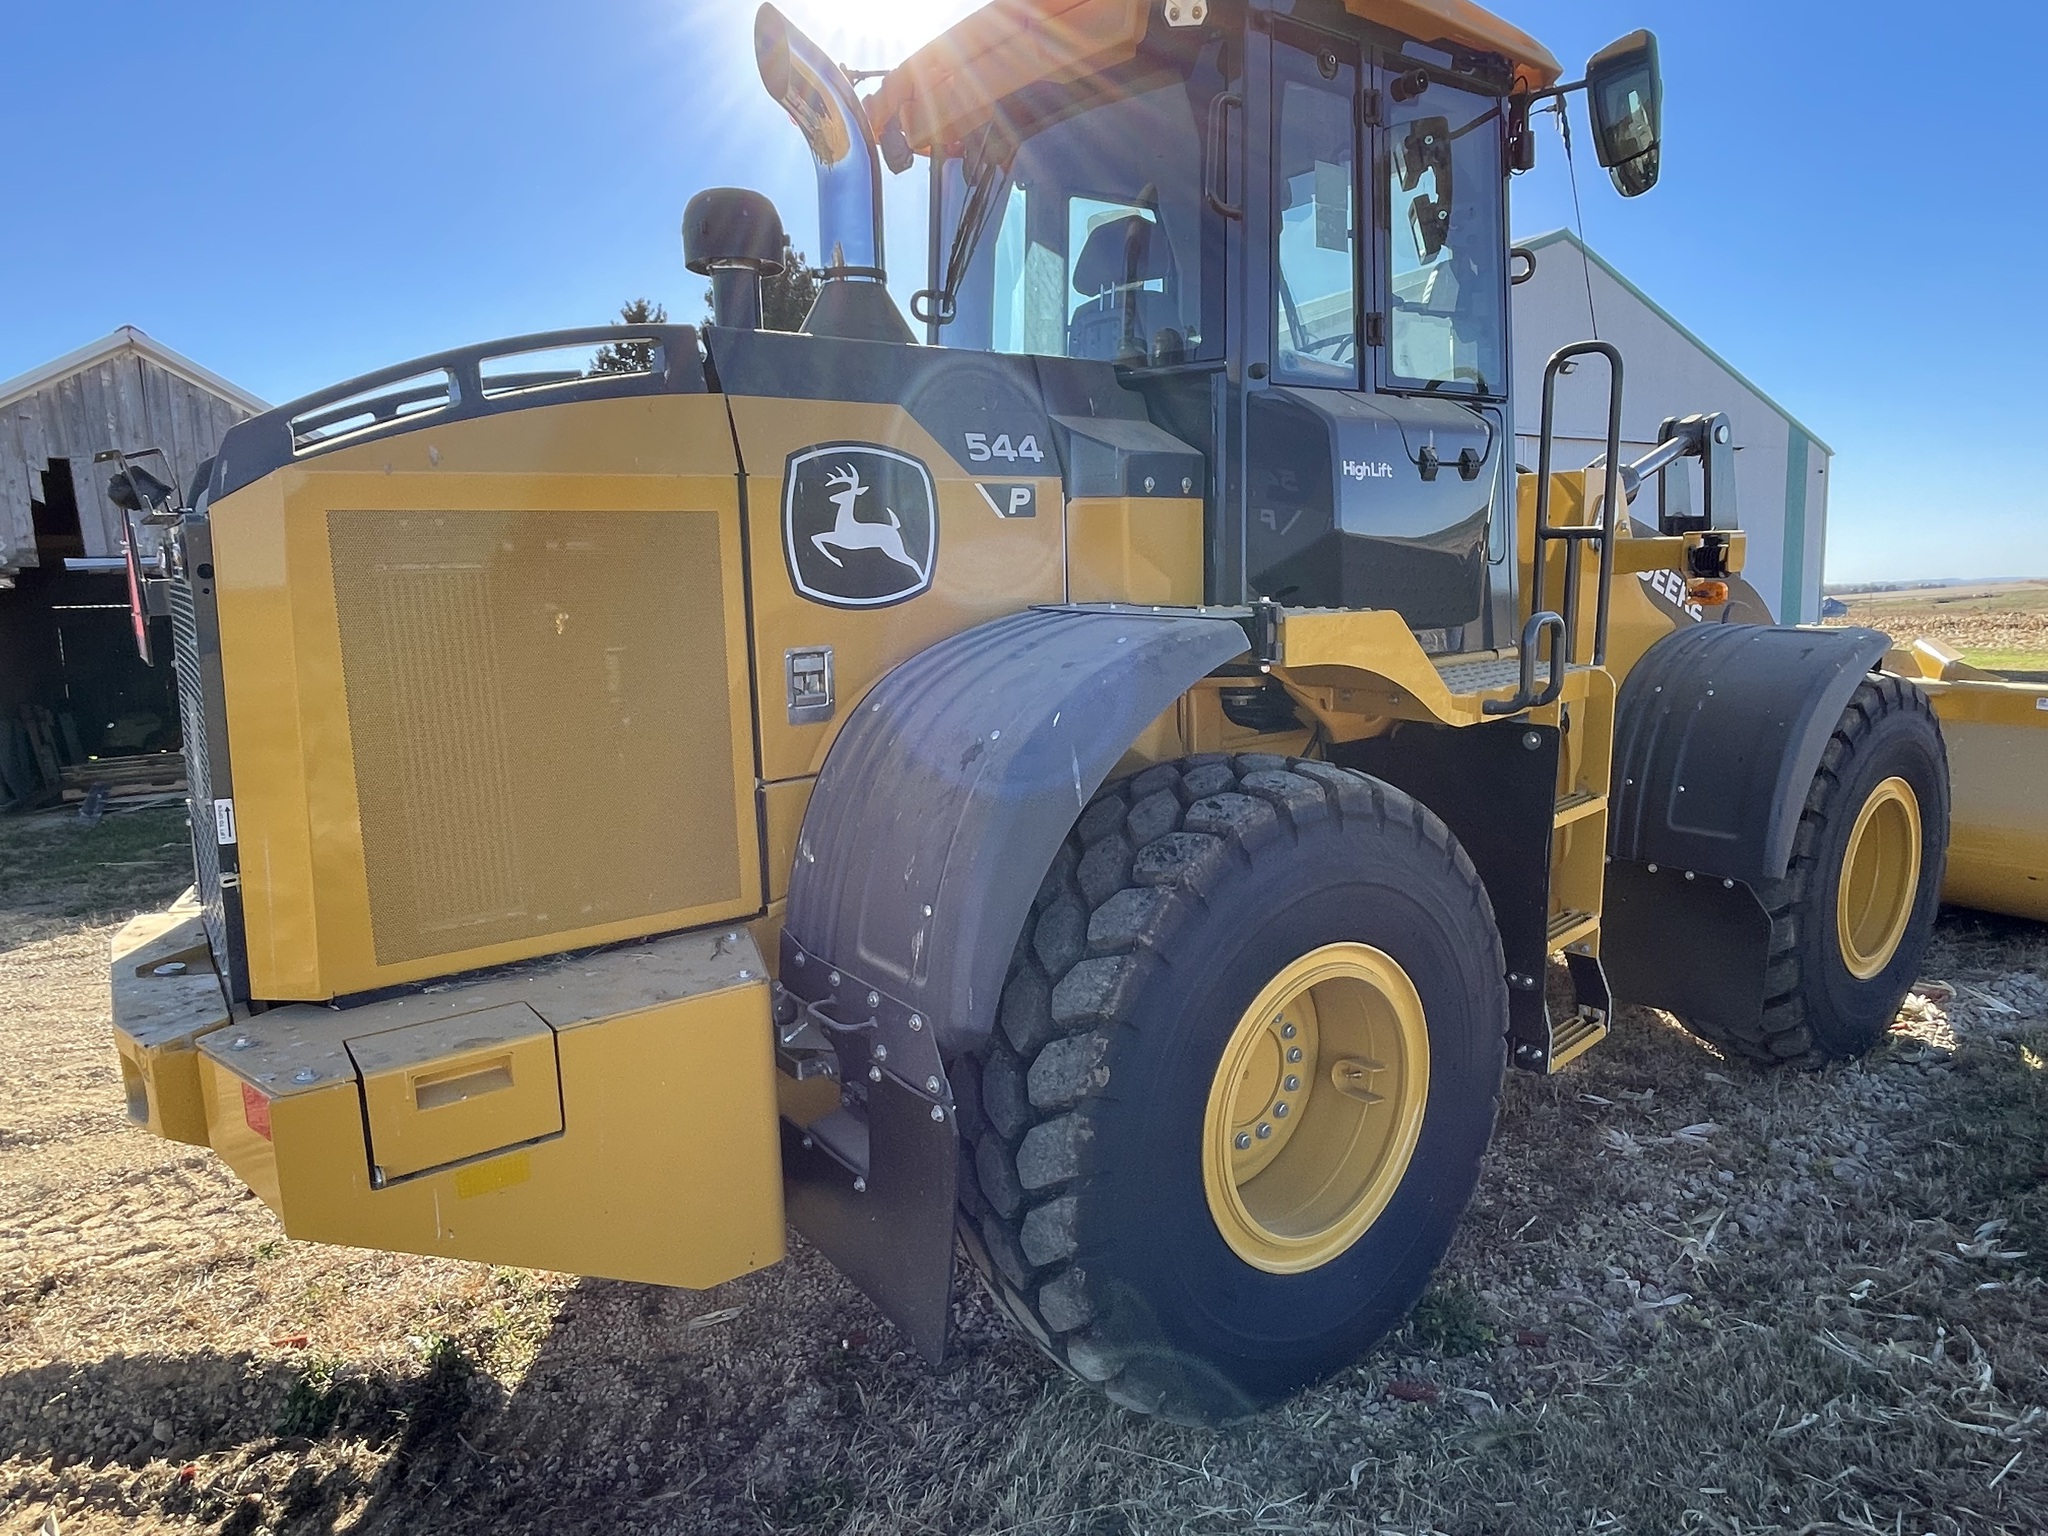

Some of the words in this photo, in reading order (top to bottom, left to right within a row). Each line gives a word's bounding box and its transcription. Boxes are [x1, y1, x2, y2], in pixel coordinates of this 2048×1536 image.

[965, 433, 1044, 462] 544
[1009, 487, 1031, 514] P
[1636, 569, 1703, 622] EEE
